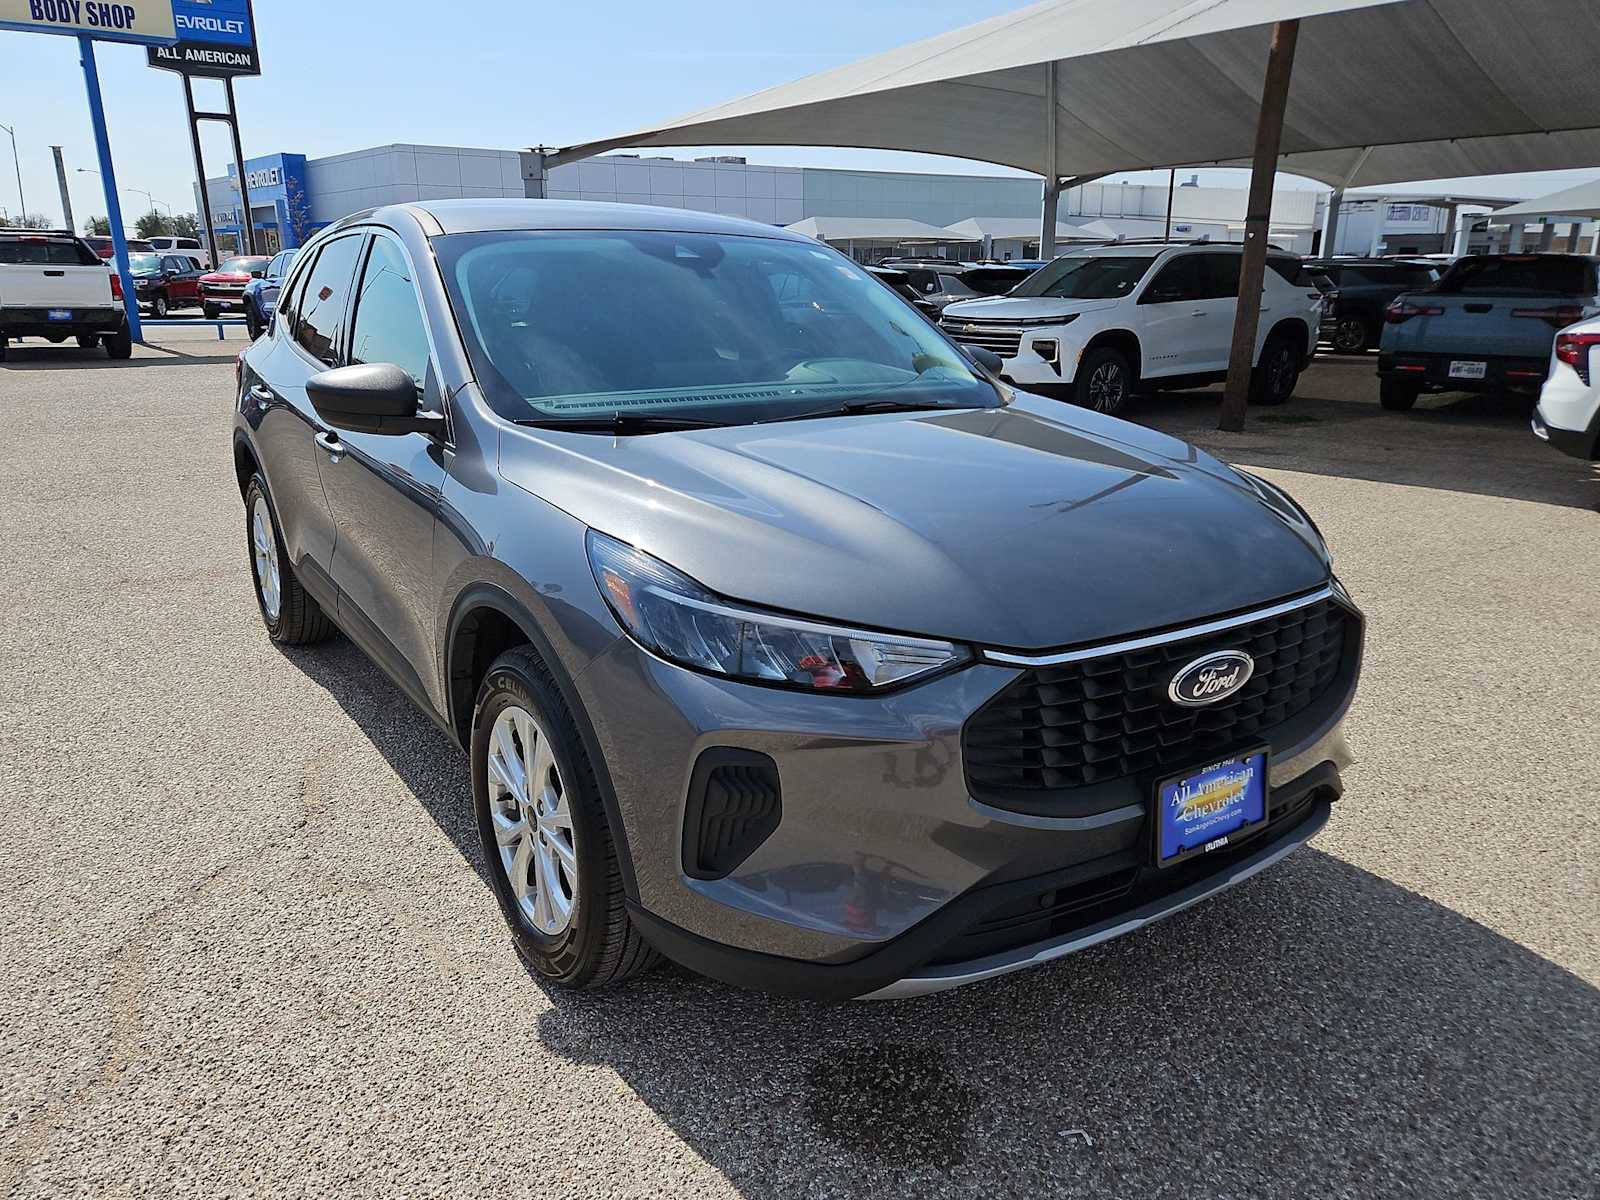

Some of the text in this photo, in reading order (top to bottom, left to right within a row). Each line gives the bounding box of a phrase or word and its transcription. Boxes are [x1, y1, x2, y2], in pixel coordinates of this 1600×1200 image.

[29, 0, 136, 29] BODY SHOP
[175, 14, 245, 34] EVROLET
[157, 47, 252, 66] ALL AMERICAN
[247, 167, 283, 190] HEVROLET
[1192, 662, 1240, 697] Ford
[1170, 767, 1254, 807] All American
[1183, 788, 1246, 822] Chevrolet
